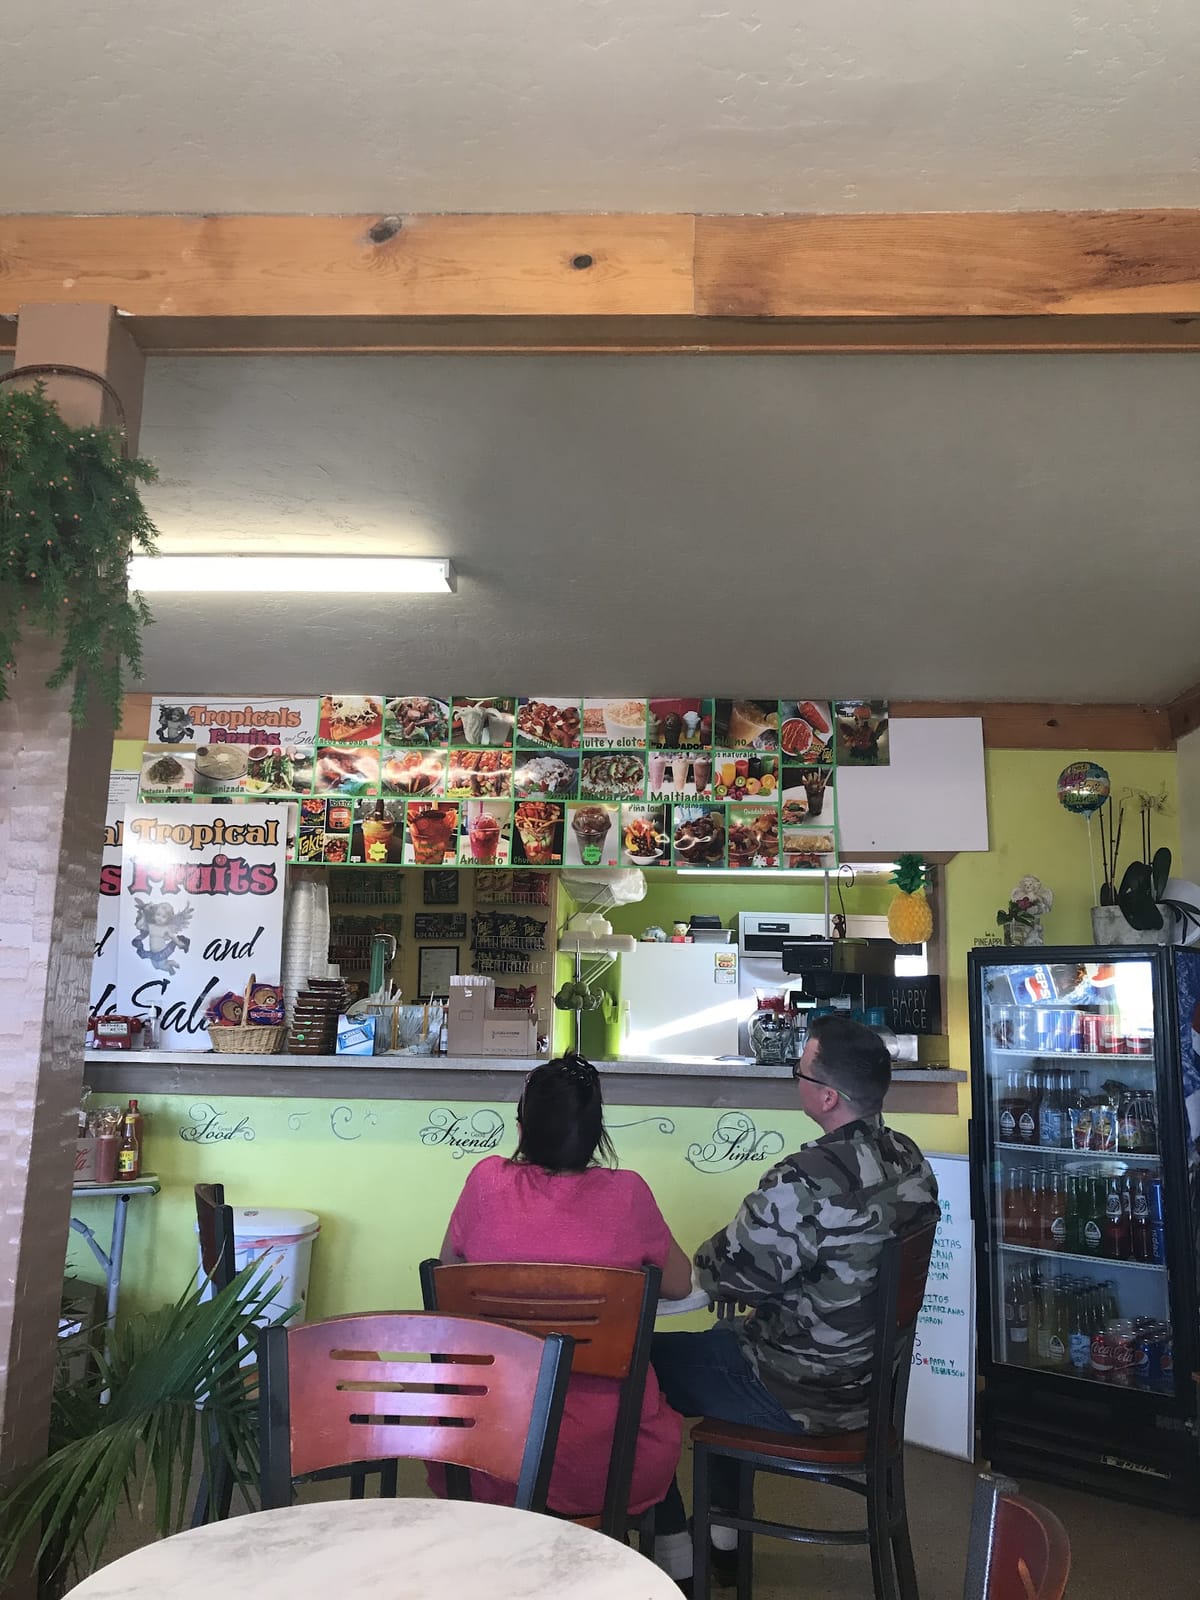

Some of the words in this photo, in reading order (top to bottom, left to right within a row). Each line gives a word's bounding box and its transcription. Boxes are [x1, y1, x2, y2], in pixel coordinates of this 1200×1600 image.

[187, 705, 302, 731] Tropicals
[208, 727, 281, 745] Fruits
[650, 791, 711, 803] Maltiadas
[130, 817, 280, 851] Tropical
[127, 853, 279, 897] Fruits
[202, 925, 266, 962] and
[973, 937, 1003, 947] PINEAPP
[891, 989, 928, 1009] HAPPY
[893, 1008, 928, 1029] PLACE
[180, 1103, 250, 1144] Food
[422, 1108, 504, 1147] Friends
[702, 1126, 768, 1163] Times
[933, 1239, 962, 1250] NITAS
[921, 1304, 965, 1317] ETARIANAS
